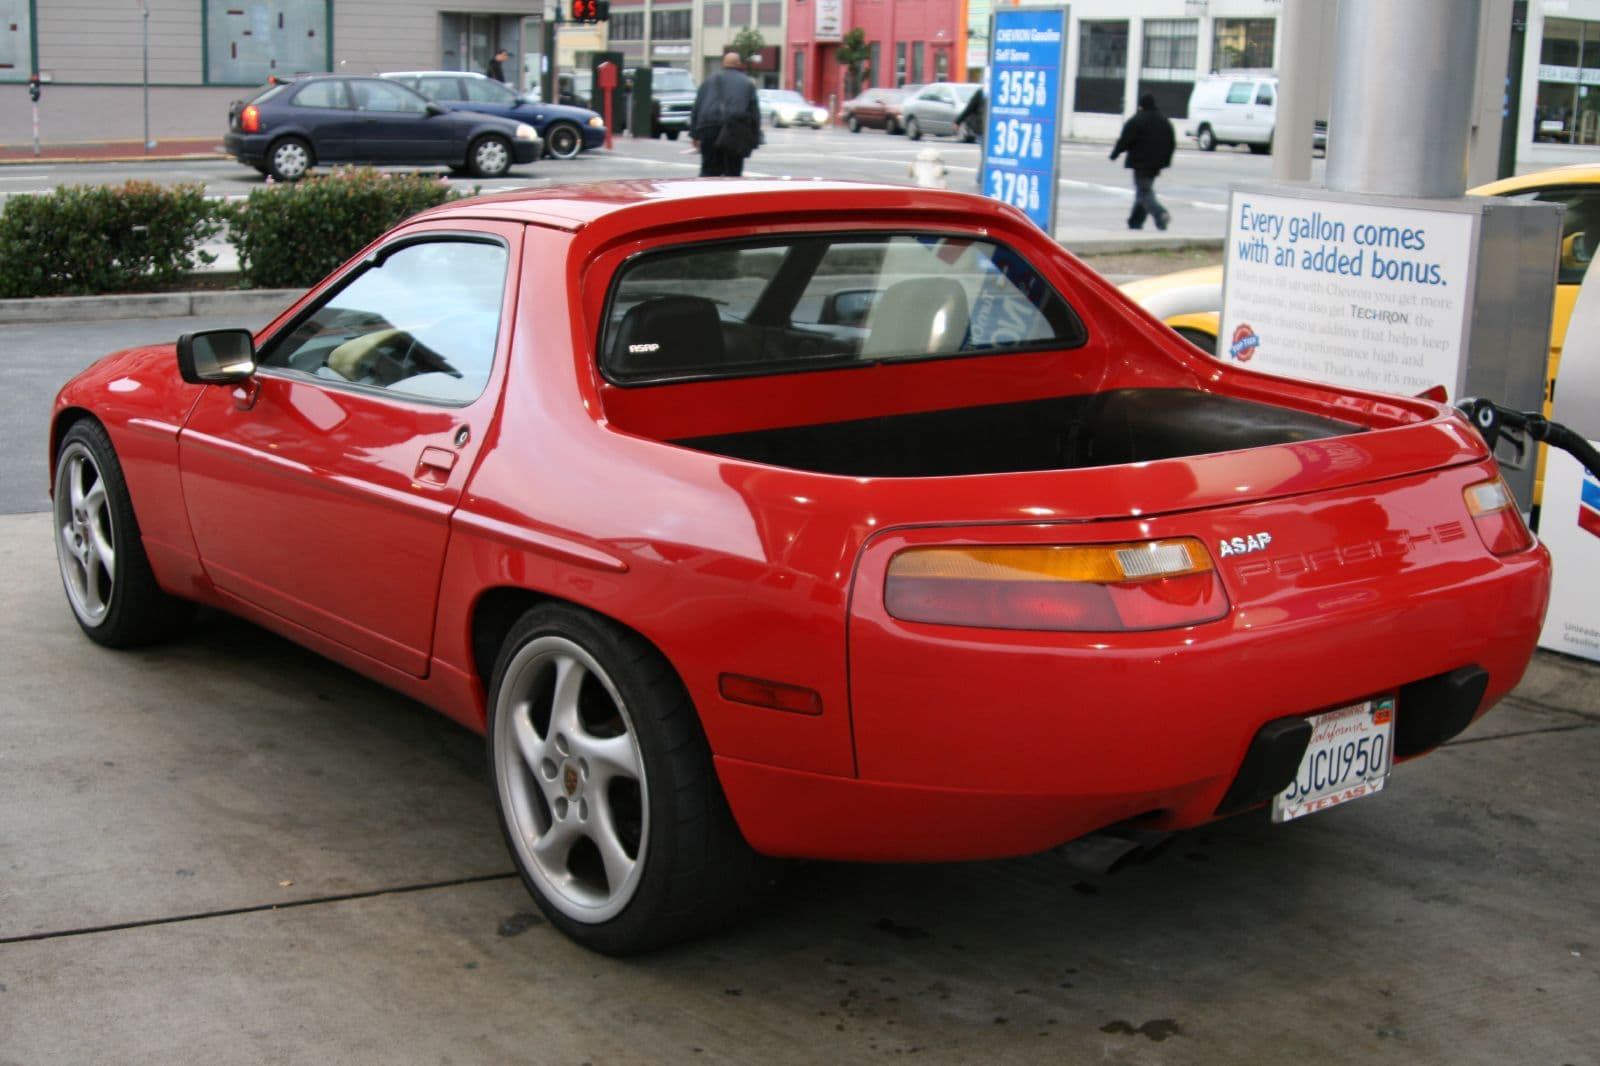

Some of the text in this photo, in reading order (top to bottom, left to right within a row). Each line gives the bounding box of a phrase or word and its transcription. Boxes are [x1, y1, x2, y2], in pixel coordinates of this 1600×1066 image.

[998, 70, 1036, 106] 355
[994, 119, 1032, 157] 367
[991, 169, 1028, 209] 379
[1240, 203, 1425, 252] Every gallon comes
[1238, 238, 1448, 286] with an added bonus.
[1326, 284, 1372, 301] Chevron
[1374, 290, 1396, 305] you
[1398, 292, 1418, 307] get
[1420, 296, 1453, 310] more
[1415, 314, 1434, 328] the
[629, 343, 660, 353] ASAP
[1362, 328, 1385, 343] that
[1388, 331, 1418, 348] helps
[1422, 337, 1450, 353] keep
[1373, 348, 1399, 365] high
[1401, 353, 1424, 368] and
[1220, 532, 1272, 558] ASAP
[1236, 520, 1467, 586] PORSCHE
[1303, 785, 1367, 813] TEXAS
